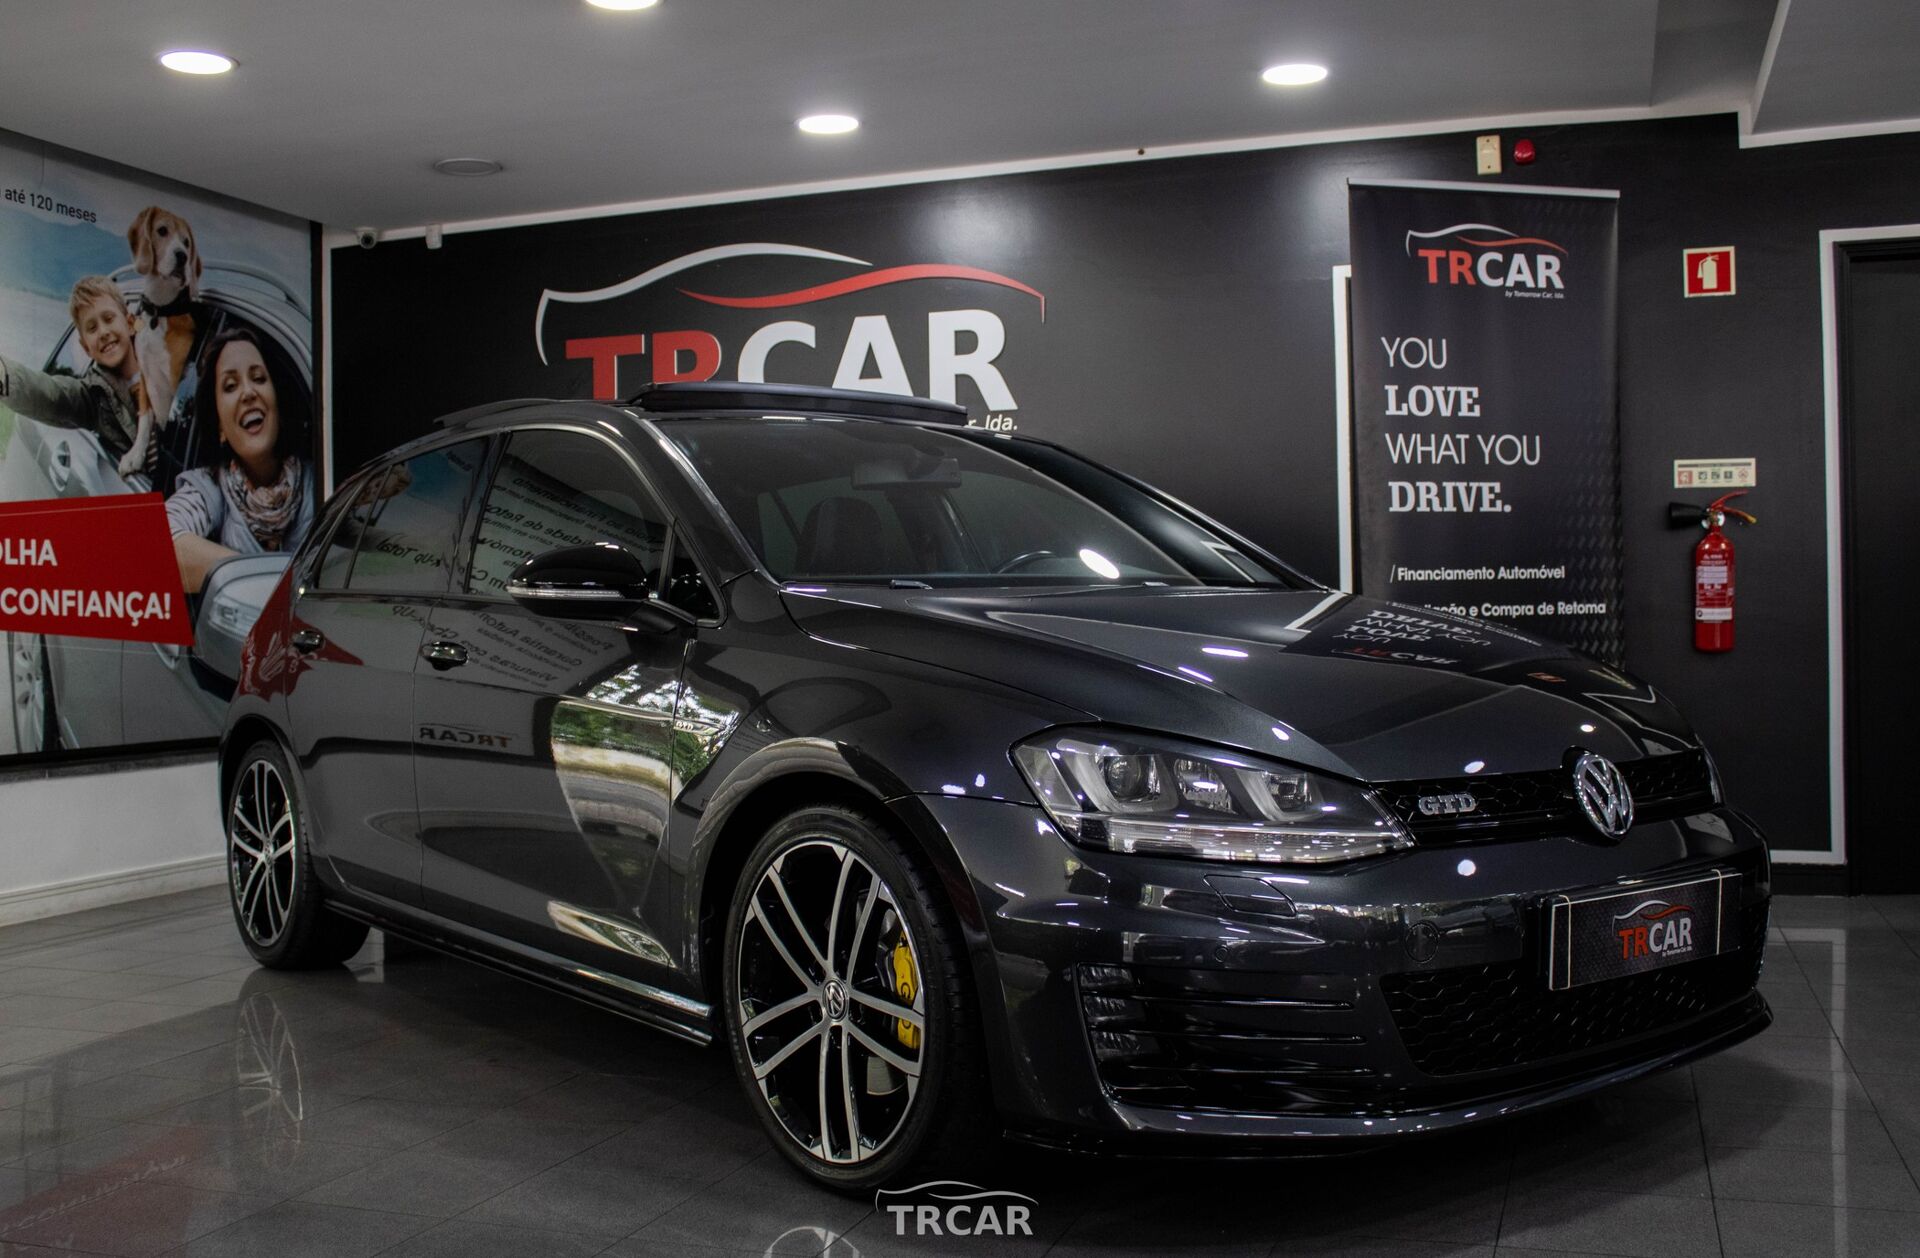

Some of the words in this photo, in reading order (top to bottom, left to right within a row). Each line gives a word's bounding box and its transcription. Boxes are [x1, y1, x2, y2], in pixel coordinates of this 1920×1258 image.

[5, 189, 26, 204] até
[29, 193, 53, 211] 120
[56, 203, 97, 223] meses
[1417, 249, 1565, 289] TRCAR
[1381, 337, 1447, 369] YOU
[1384, 385, 1480, 418] LOVE
[1385, 433, 1469, 465] WHAT
[1477, 434, 1541, 466] YOU
[1388, 481, 1512, 513] DRIVE.
[0, 538, 58, 566] LHA
[1497, 565, 1565, 580] Automóvel
[1, 587, 171, 627] CONFIANÇA!
[1469, 605, 1478, 616] e
[1481, 603, 1535, 619] Compra
[1537, 602, 1555, 615] de
[1557, 601, 1606, 614] Retoma
[1418, 793, 1477, 816] GTD
[1616, 917, 1693, 961] TRCAR
